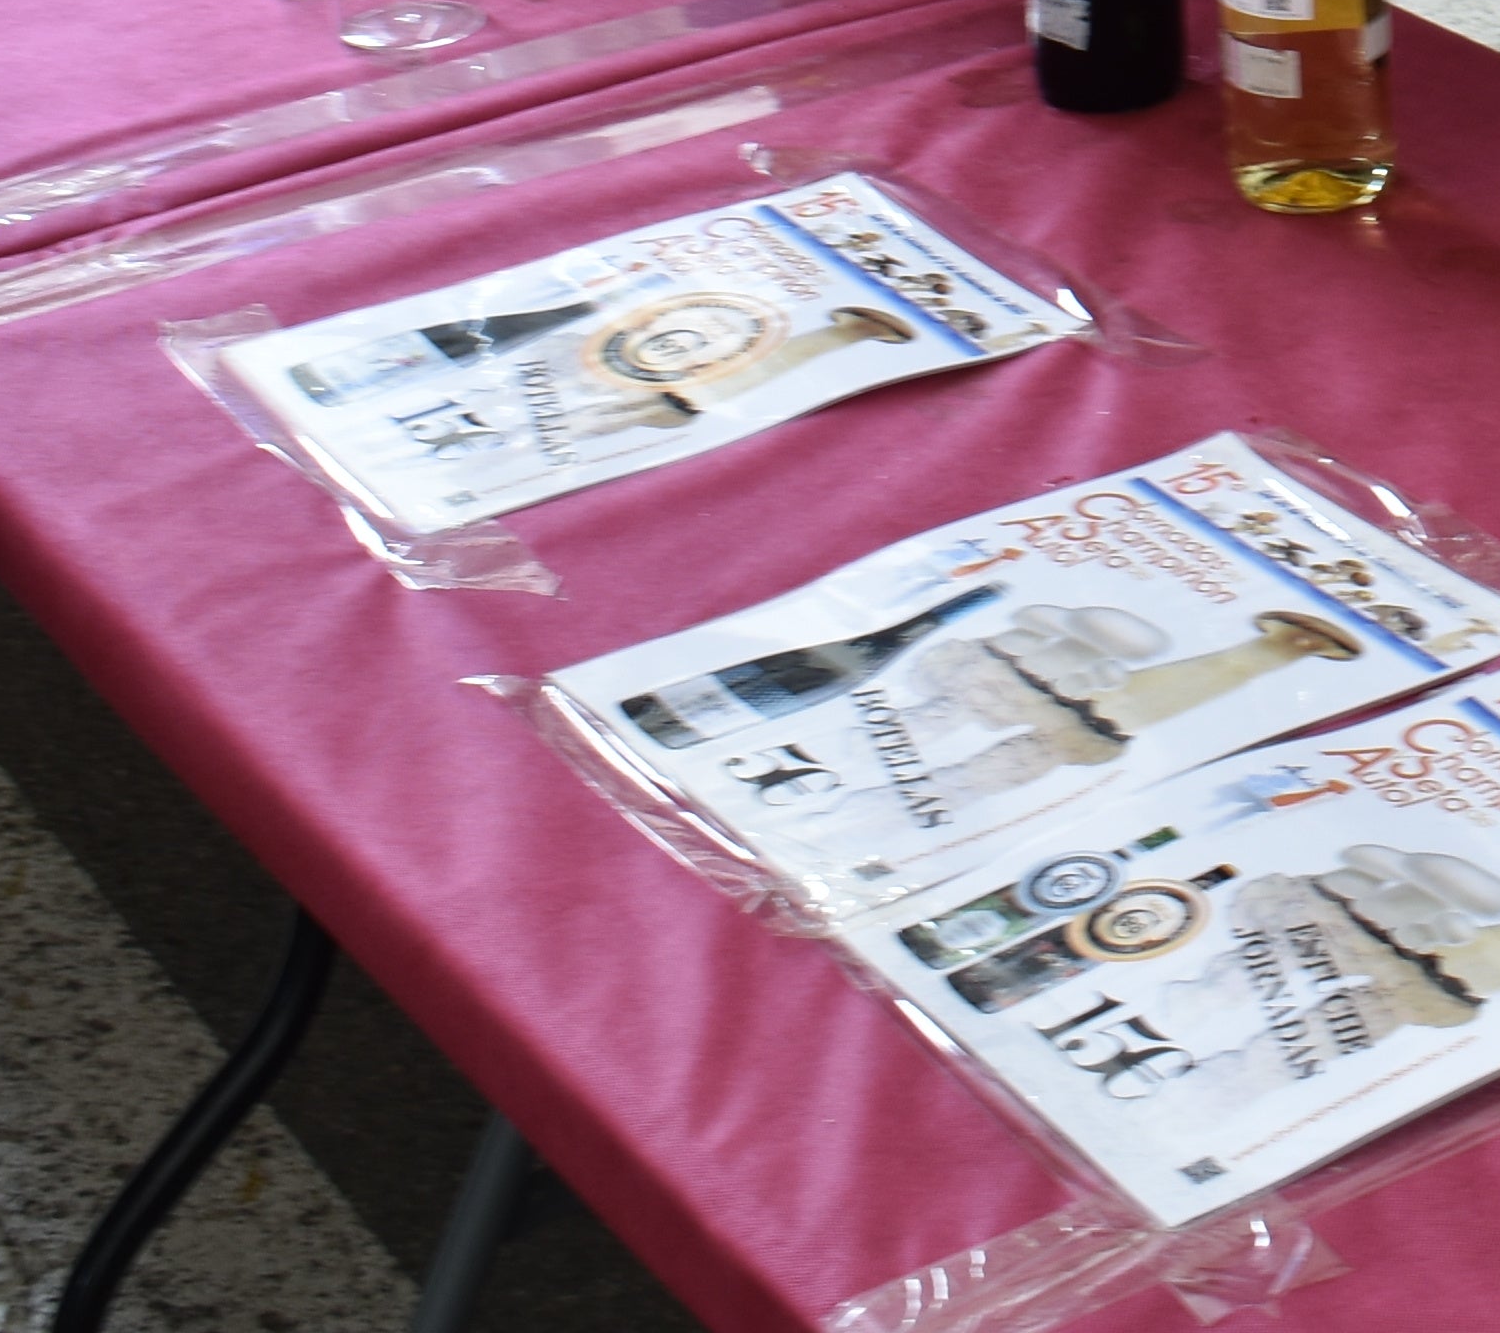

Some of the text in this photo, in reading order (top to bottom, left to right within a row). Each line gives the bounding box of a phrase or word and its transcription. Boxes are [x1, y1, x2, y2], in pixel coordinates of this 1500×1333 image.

[722, 743, 847, 807] 5€
[851, 688, 954, 829] BOTELLAS
[1320, 746, 1418, 809] Autol
[1029, 989, 1196, 1100] 15€
[1232, 927, 1325, 1081] JORNADAS
[1287, 923, 1375, 1055] ESTUCHE
